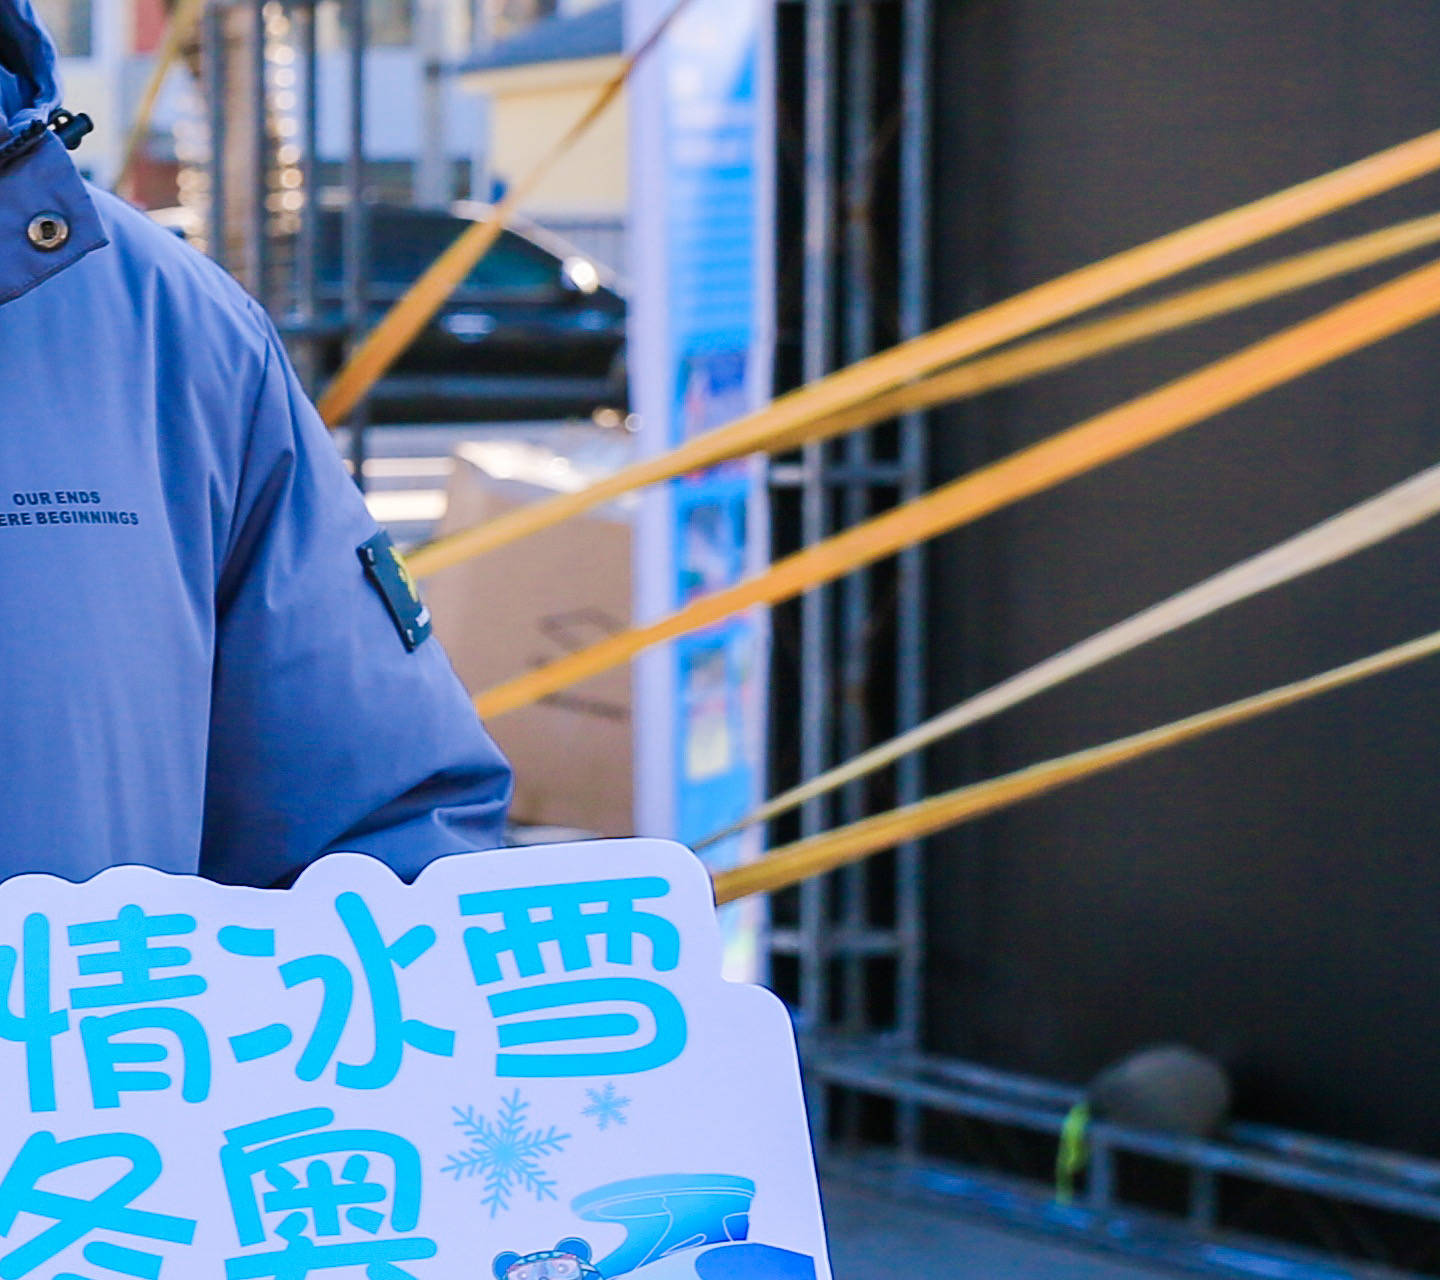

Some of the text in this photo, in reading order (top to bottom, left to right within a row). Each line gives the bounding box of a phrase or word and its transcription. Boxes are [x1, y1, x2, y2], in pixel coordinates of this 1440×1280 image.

[12, 490, 101, 507] OUR ENDS
[35, 511, 139, 526] BEGINNINGS
